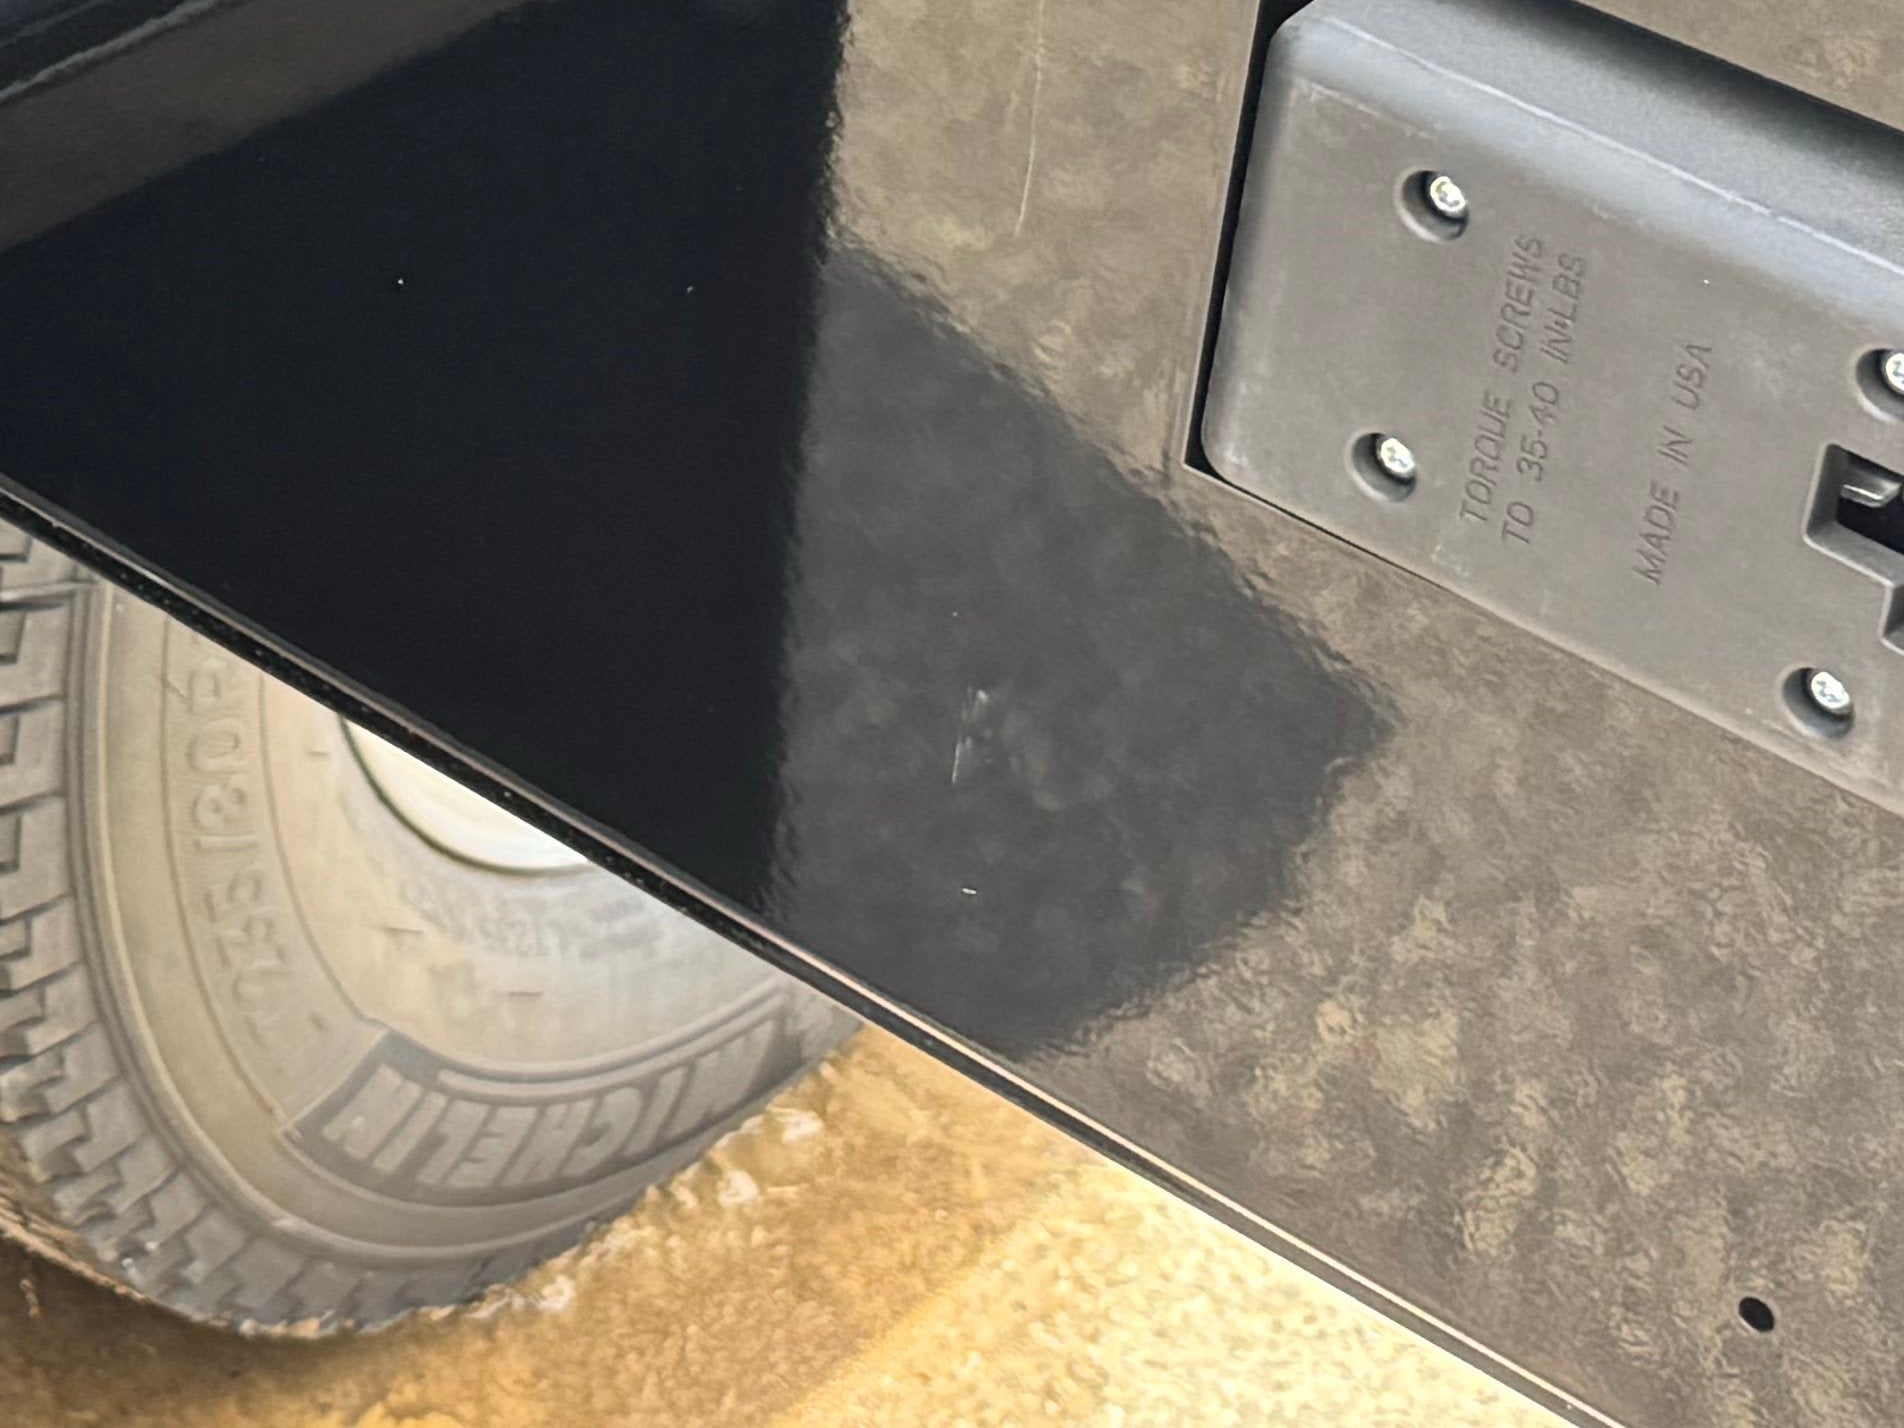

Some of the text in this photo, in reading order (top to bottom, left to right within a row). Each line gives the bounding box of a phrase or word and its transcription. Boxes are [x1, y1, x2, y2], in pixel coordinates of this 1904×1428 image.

[1458, 233, 1544, 524] TORQUE SCREWS
[1500, 500, 1534, 546] TO
[1517, 380, 1561, 482] 35-40
[1632, 344, 1712, 585] MADE IN USA
[322, 1012, 778, 1192] MICHELIN
